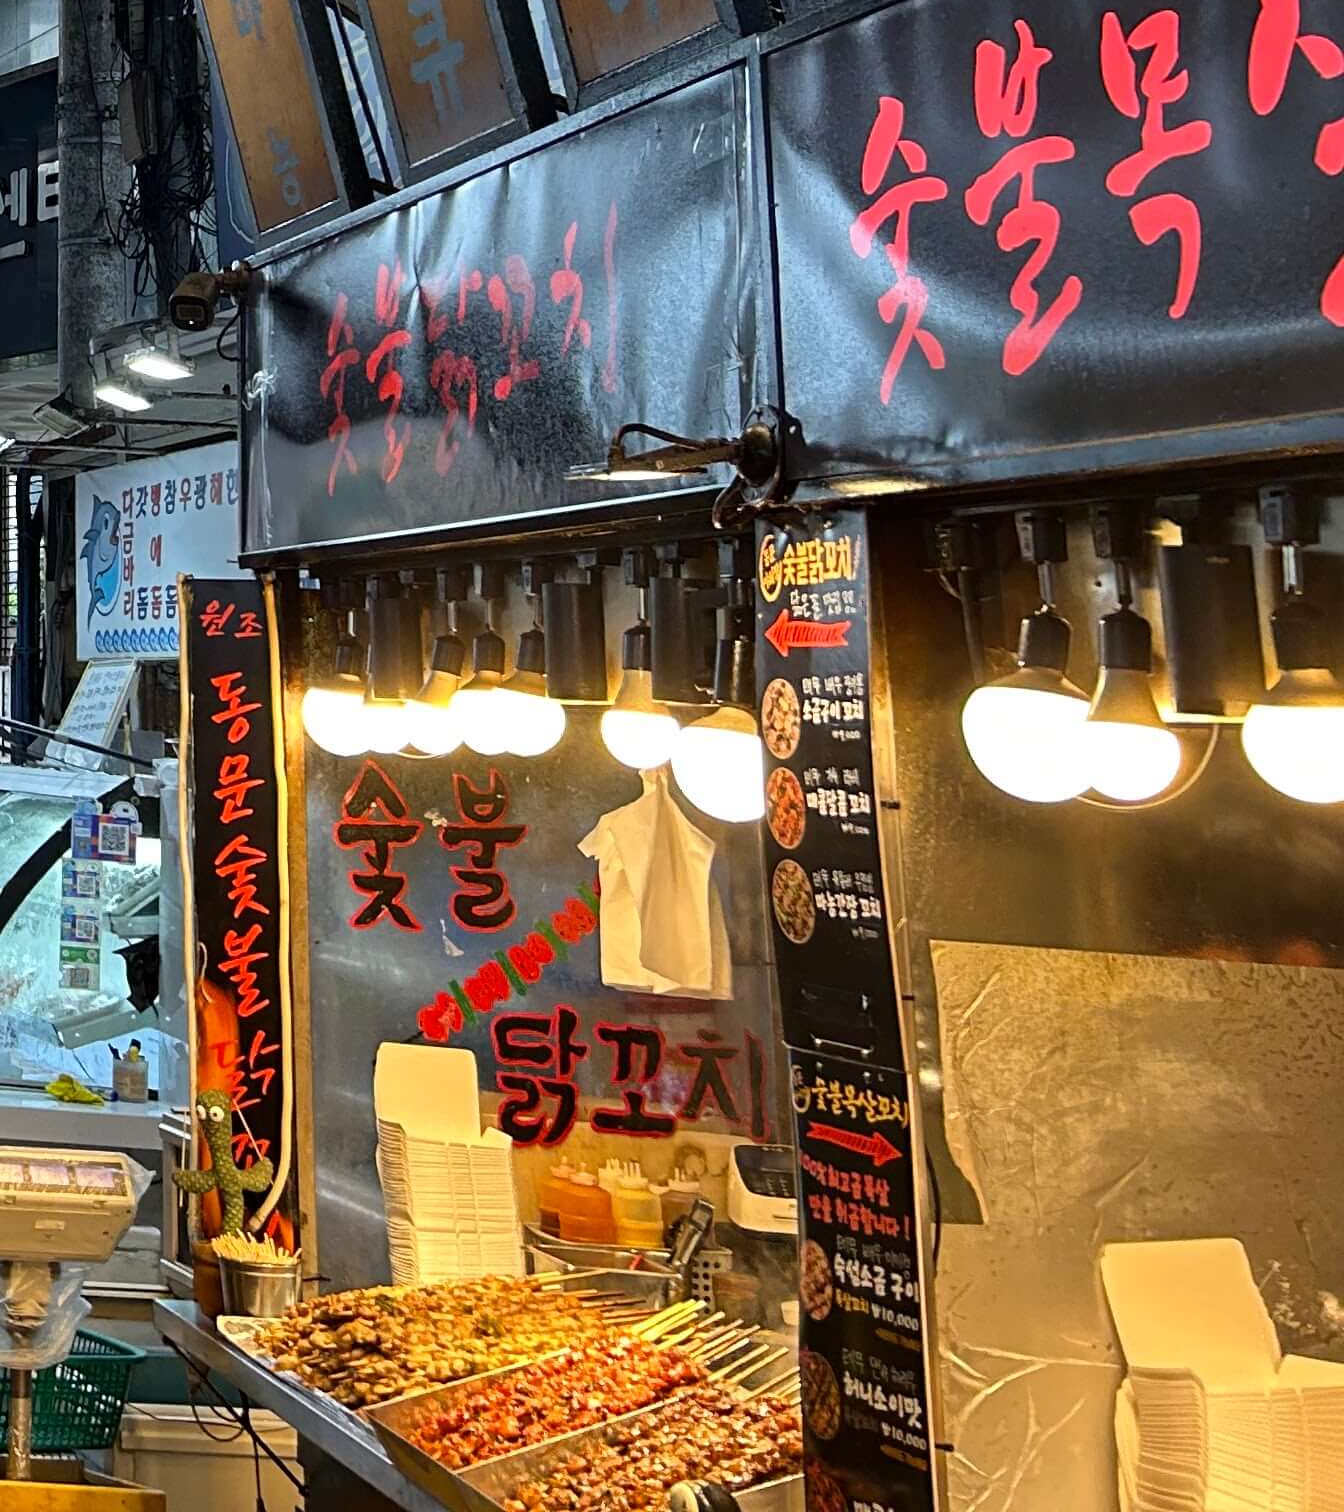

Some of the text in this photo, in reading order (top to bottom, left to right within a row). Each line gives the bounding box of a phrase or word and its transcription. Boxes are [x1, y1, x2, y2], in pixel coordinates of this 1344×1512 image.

[201, 600, 262, 639] 원조
[802, 697, 841, 725] 소금구이
[334, 759, 528, 933] 숯불
[491, 1004, 772, 1148] 닭꼬치
[843, 1370, 923, 1430] 허니소이맛
